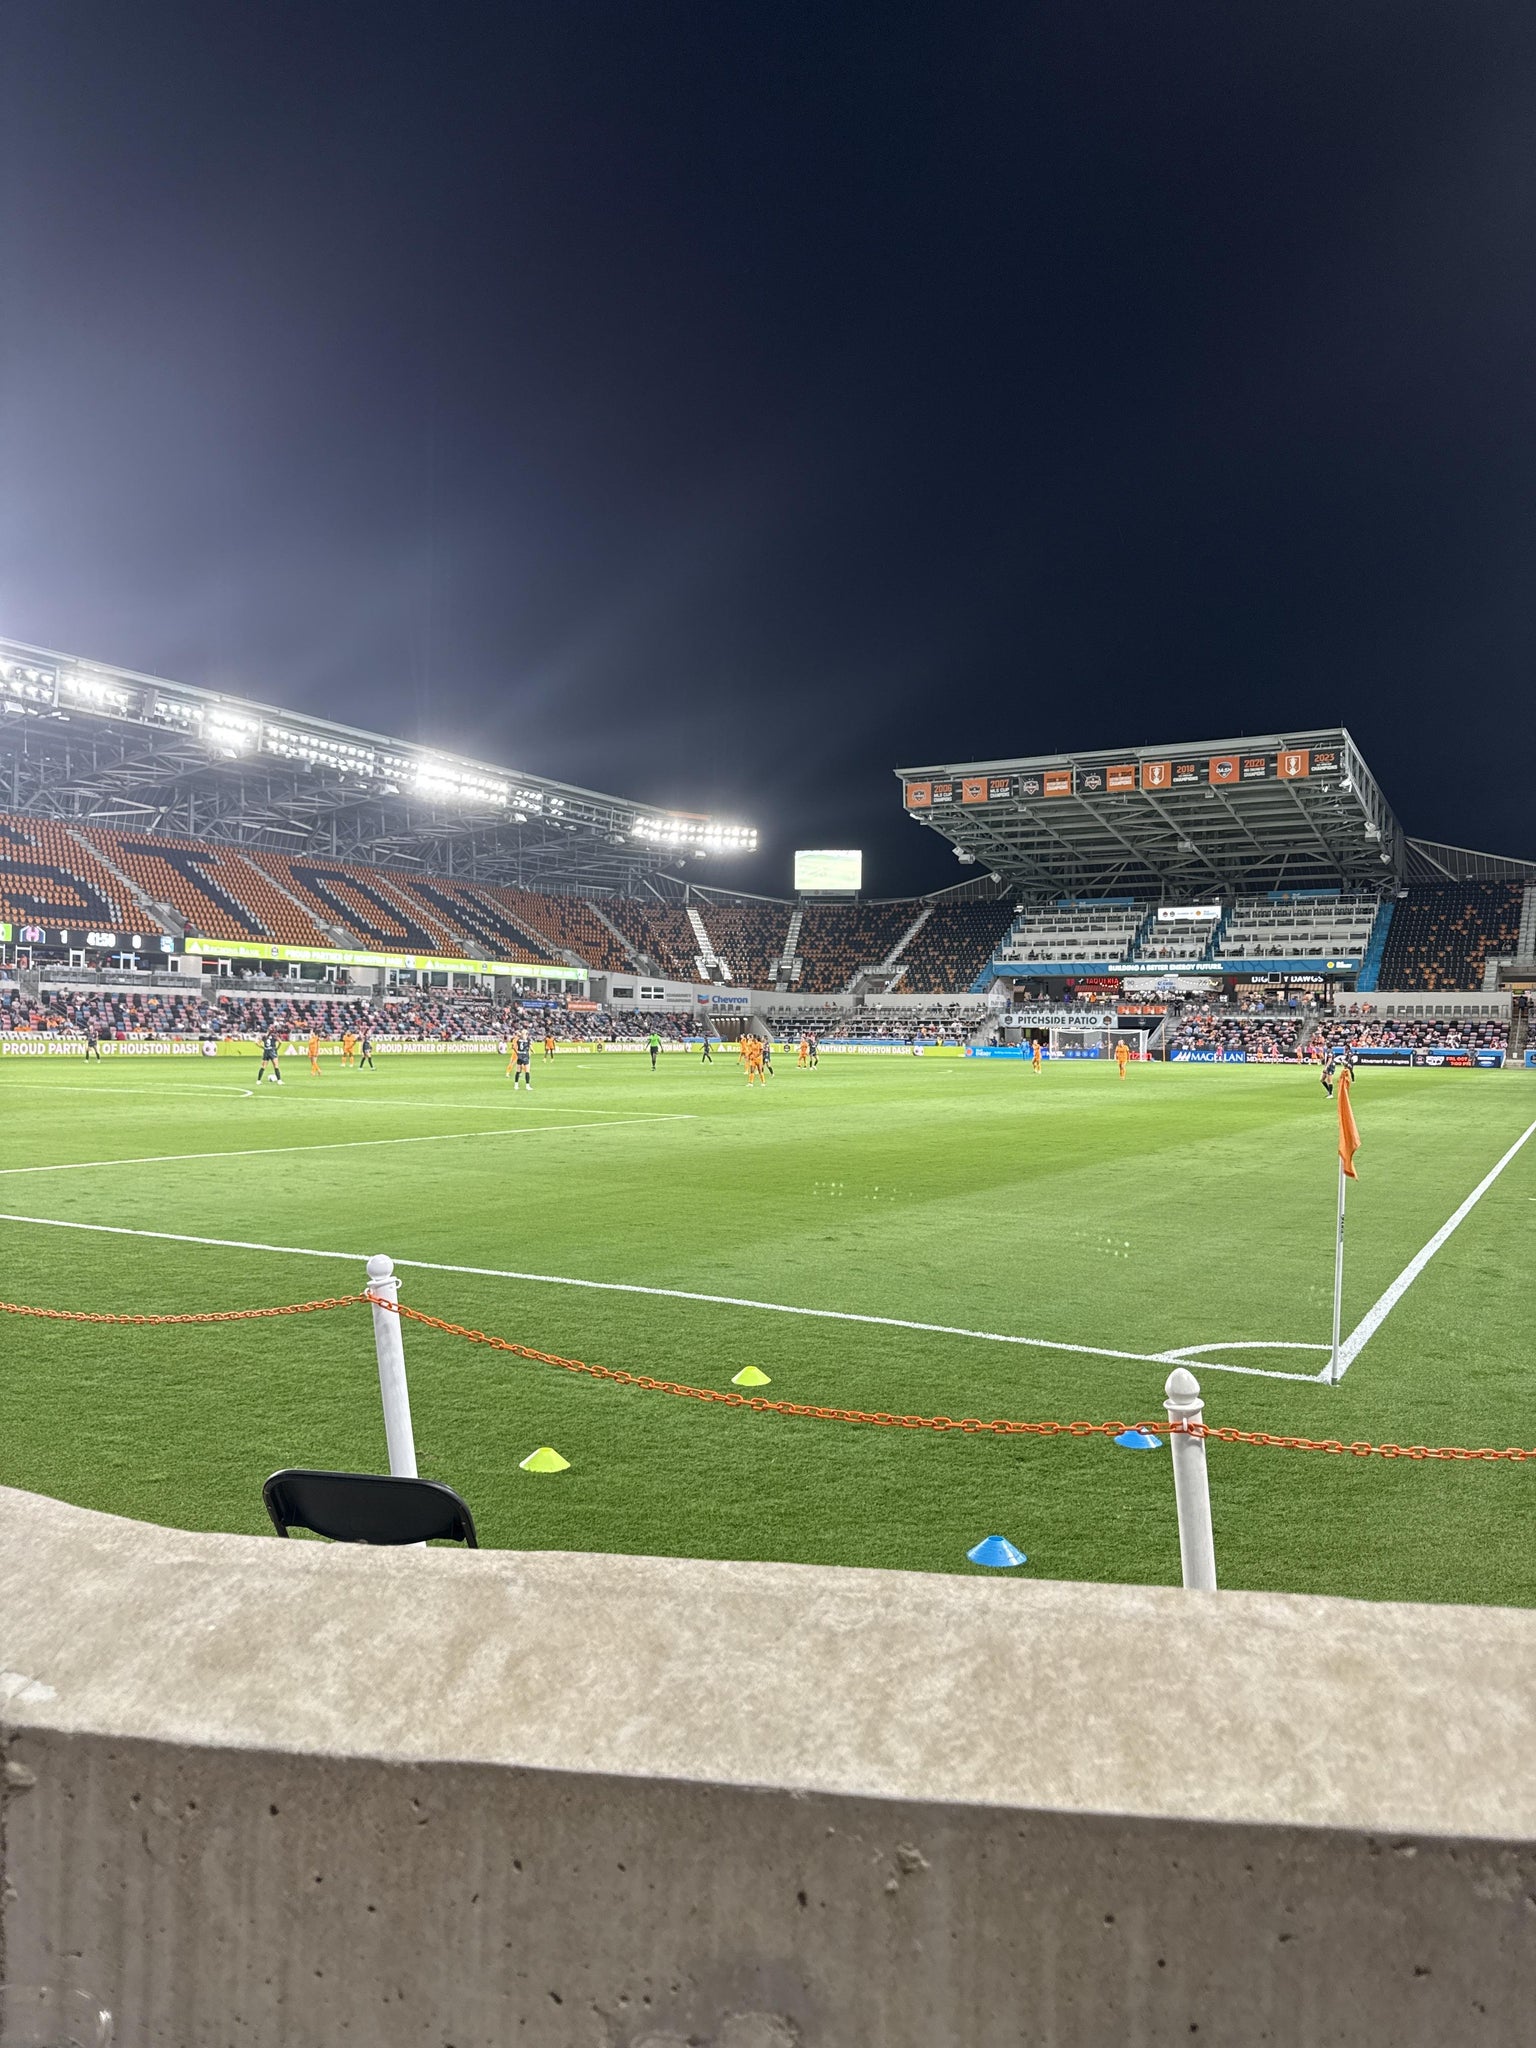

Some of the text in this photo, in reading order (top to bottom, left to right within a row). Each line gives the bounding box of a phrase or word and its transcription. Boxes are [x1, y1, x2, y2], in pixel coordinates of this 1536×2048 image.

[1314, 753, 1335, 762] 2023
[1244, 758, 1265, 768] 2020
[1176, 765, 1195, 773] 2018
[990, 779, 1009, 788] 2007
[60, 930, 68, 944] 1
[712, 995, 748, 1004] Chevron
[1017, 1015, 1098, 1025] PITCHSIDE PATIO
[2, 1043, 46, 1055] PROUD
[102, 1043, 117, 1054] OF
[119, 1043, 170, 1054] HOUSTON
[172, 1043, 199, 1054] DASH
[376, 1043, 497, 1052] PROUD PARTNER OF HOUSTON DASH
